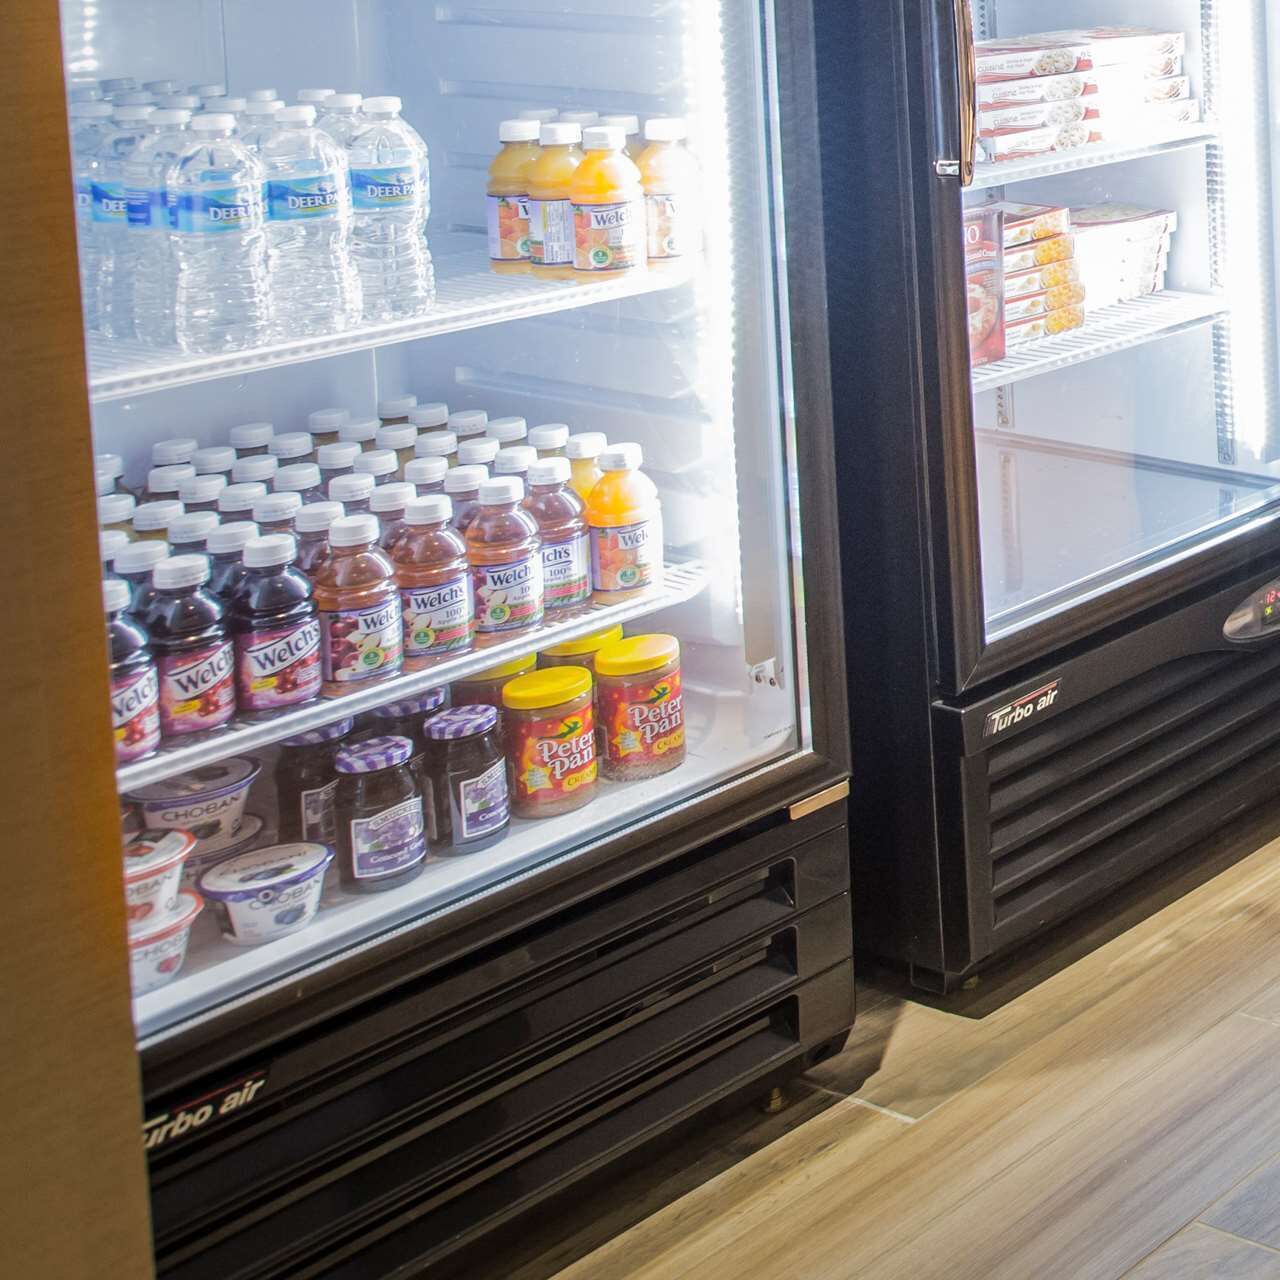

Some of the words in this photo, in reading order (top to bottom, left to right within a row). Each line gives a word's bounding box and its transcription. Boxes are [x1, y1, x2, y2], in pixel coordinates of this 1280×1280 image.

[288, 196, 324, 209] DEER
[367, 184, 401, 198] DEER
[102, 199, 126, 212] DEE
[594, 210, 625, 226] Welc
[491, 565, 531, 587] Welch
[628, 696, 682, 724] Peter
[988, 707, 1033, 735] Turbo
[1037, 688, 1058, 712] air
[640, 712, 681, 743] Pan
[536, 729, 594, 762] Peter
[550, 749, 594, 780] Pan
[161, 795, 241, 821] CHOBAN
[219, 1079, 266, 1115] air
